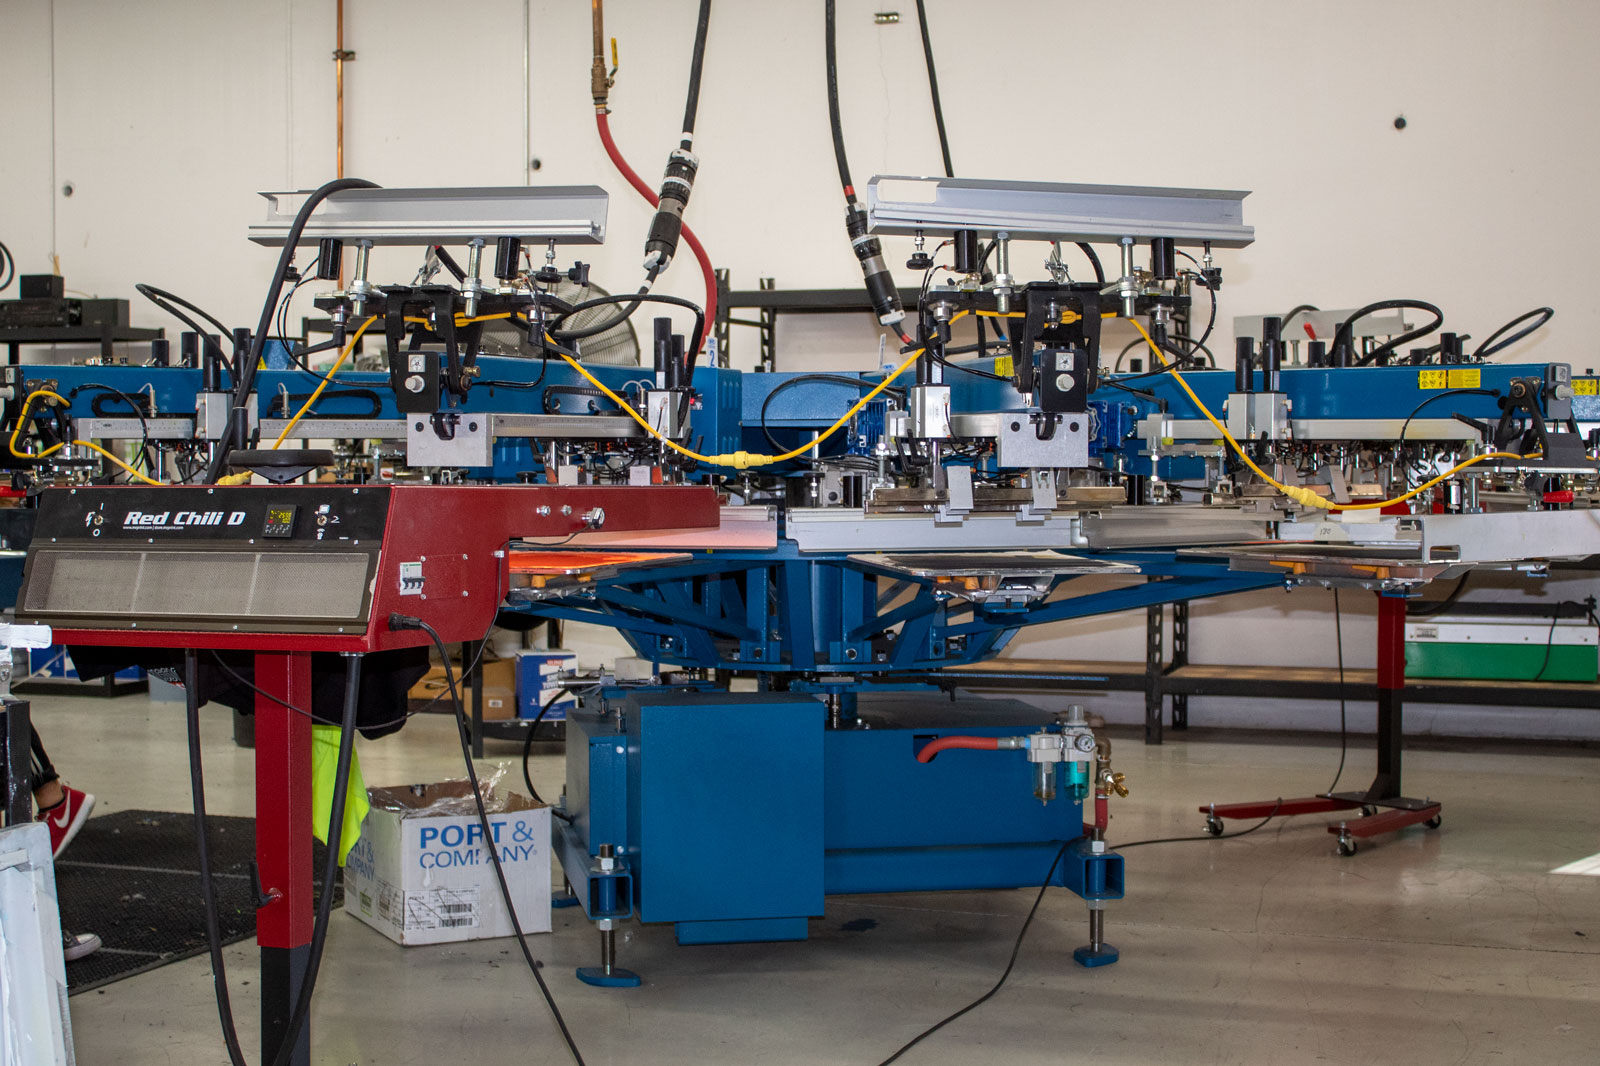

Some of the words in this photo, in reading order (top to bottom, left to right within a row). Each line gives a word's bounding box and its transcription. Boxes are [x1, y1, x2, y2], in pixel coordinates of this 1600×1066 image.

[124, 511, 170, 525] Red
[173, 511, 224, 525] Chili
[227, 511, 246, 525] D
[420, 822, 507, 849] PORT
[512, 820, 534, 842] &
